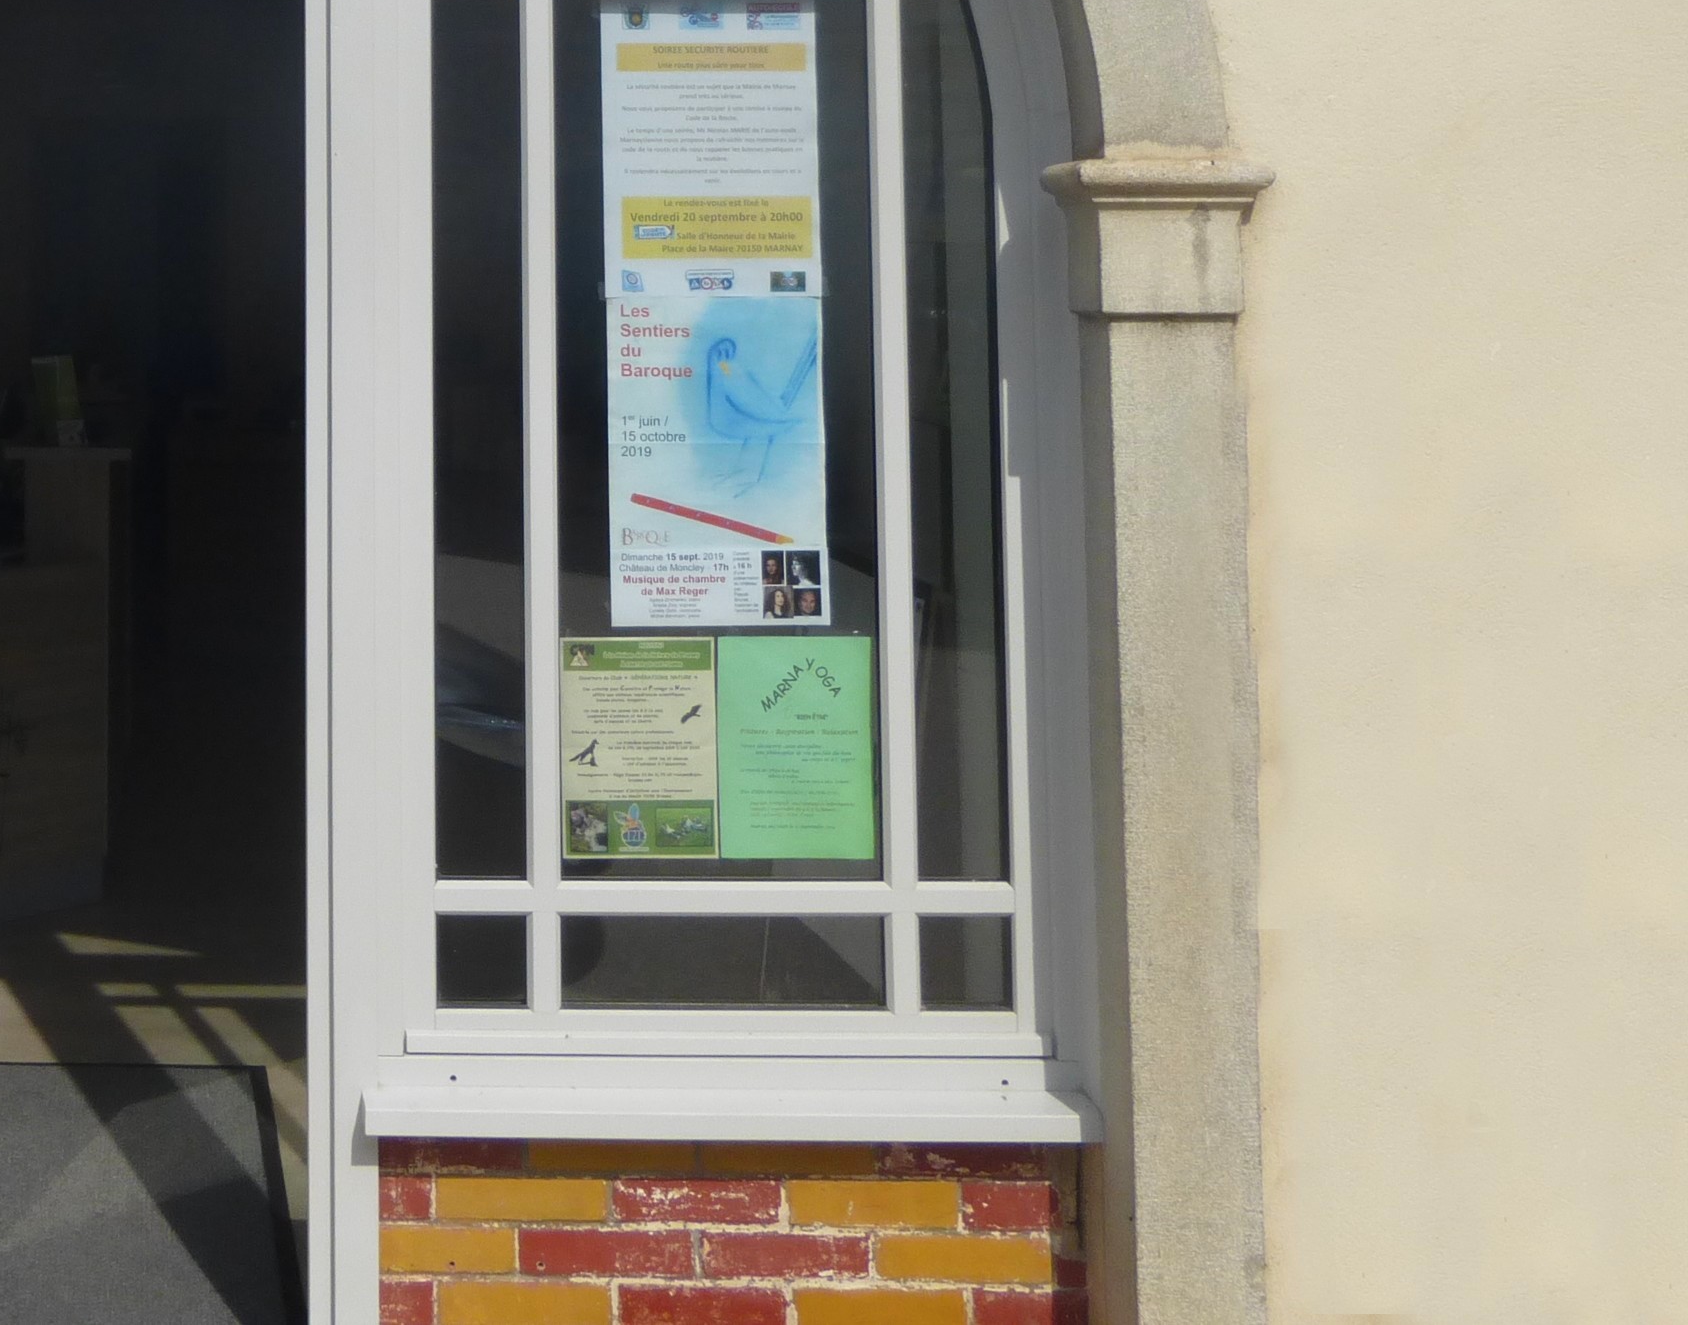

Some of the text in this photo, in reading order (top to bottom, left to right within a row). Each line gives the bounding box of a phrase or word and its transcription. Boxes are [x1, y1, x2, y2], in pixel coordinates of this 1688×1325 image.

[630, 212, 679, 223] Vendredi
[682, 212, 695, 223] 20
[699, 212, 757, 223] septembre
[770, 212, 803, 223] 20h00
[620, 303, 650, 318] Les
[620, 323, 691, 338] Sentiers
[620, 343, 641, 357] du
[620, 362, 693, 380] Baroque
[638, 415, 661, 429] juin
[621, 431, 687, 442] 15 octobre
[620, 445, 652, 457] 2019
[621, 553, 724, 562] Dimanche 15 sept. 2019
[619, 563, 655, 572] Château
[657, 564, 668, 572] de
[713, 563, 729, 571] 17h
[623, 575, 726, 584] Musique de chambre
[641, 587, 709, 596] de Max Reger
